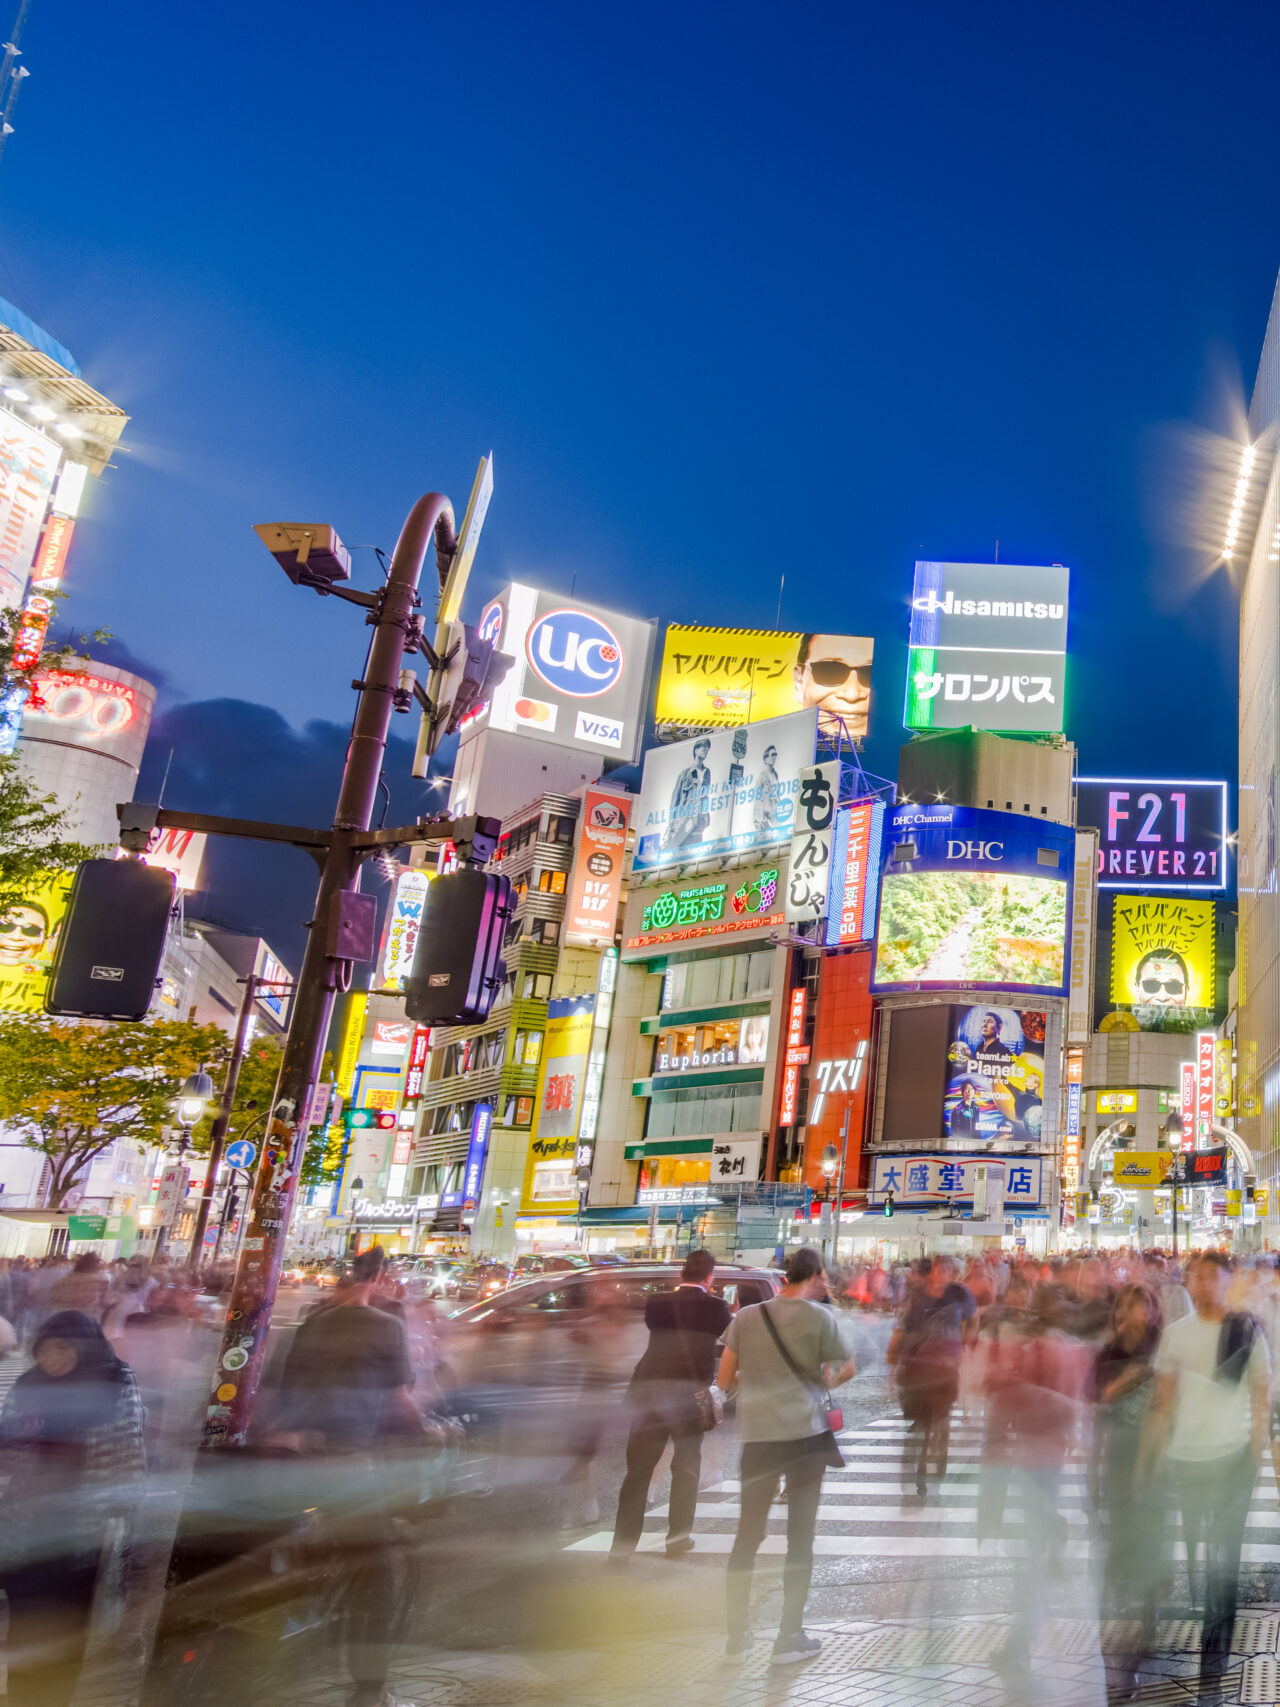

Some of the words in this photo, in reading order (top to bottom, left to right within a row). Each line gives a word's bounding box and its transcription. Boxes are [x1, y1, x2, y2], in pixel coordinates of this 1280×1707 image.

[539, 624, 618, 680] UC
[673, 653, 789, 679] ヤバババーン
[914, 672, 1055, 704] サロンパス
[582, 720, 620, 741] VISA
[646, 809, 666, 826] ALL
[701, 795, 731, 814] BEST
[914, 813, 953, 824] Channel
[1108, 792, 1186, 842] F21
[790, 768, 834, 914] もんじゃ
[946, 840, 1004, 861] DHC
[840, 810, 865, 934] 三千里薬品
[1097, 849, 1186, 875] OREVER
[1193, 851, 1217, 875] 21
[680, 888, 700, 899] FRUITS
[703, 884, 726, 896] PARLOR
[678, 894, 725, 925] 西村
[1120, 904, 1207, 928] ヤバババーン
[1128, 923, 1198, 942] ヤバババーン
[659, 1049, 734, 1071] Euphoria
[967, 1060, 1025, 1078] Planets
[976, 1051, 1011, 1062] teamLab
[1199, 1043, 1213, 1105] カラオケ
[546, 1074, 576, 1112] 薬
[1217, 1099, 1229, 1108] 4F
[476, 1111, 489, 1143] MIZUHO
[881, 1163, 1032, 1194] 大盛堂店
